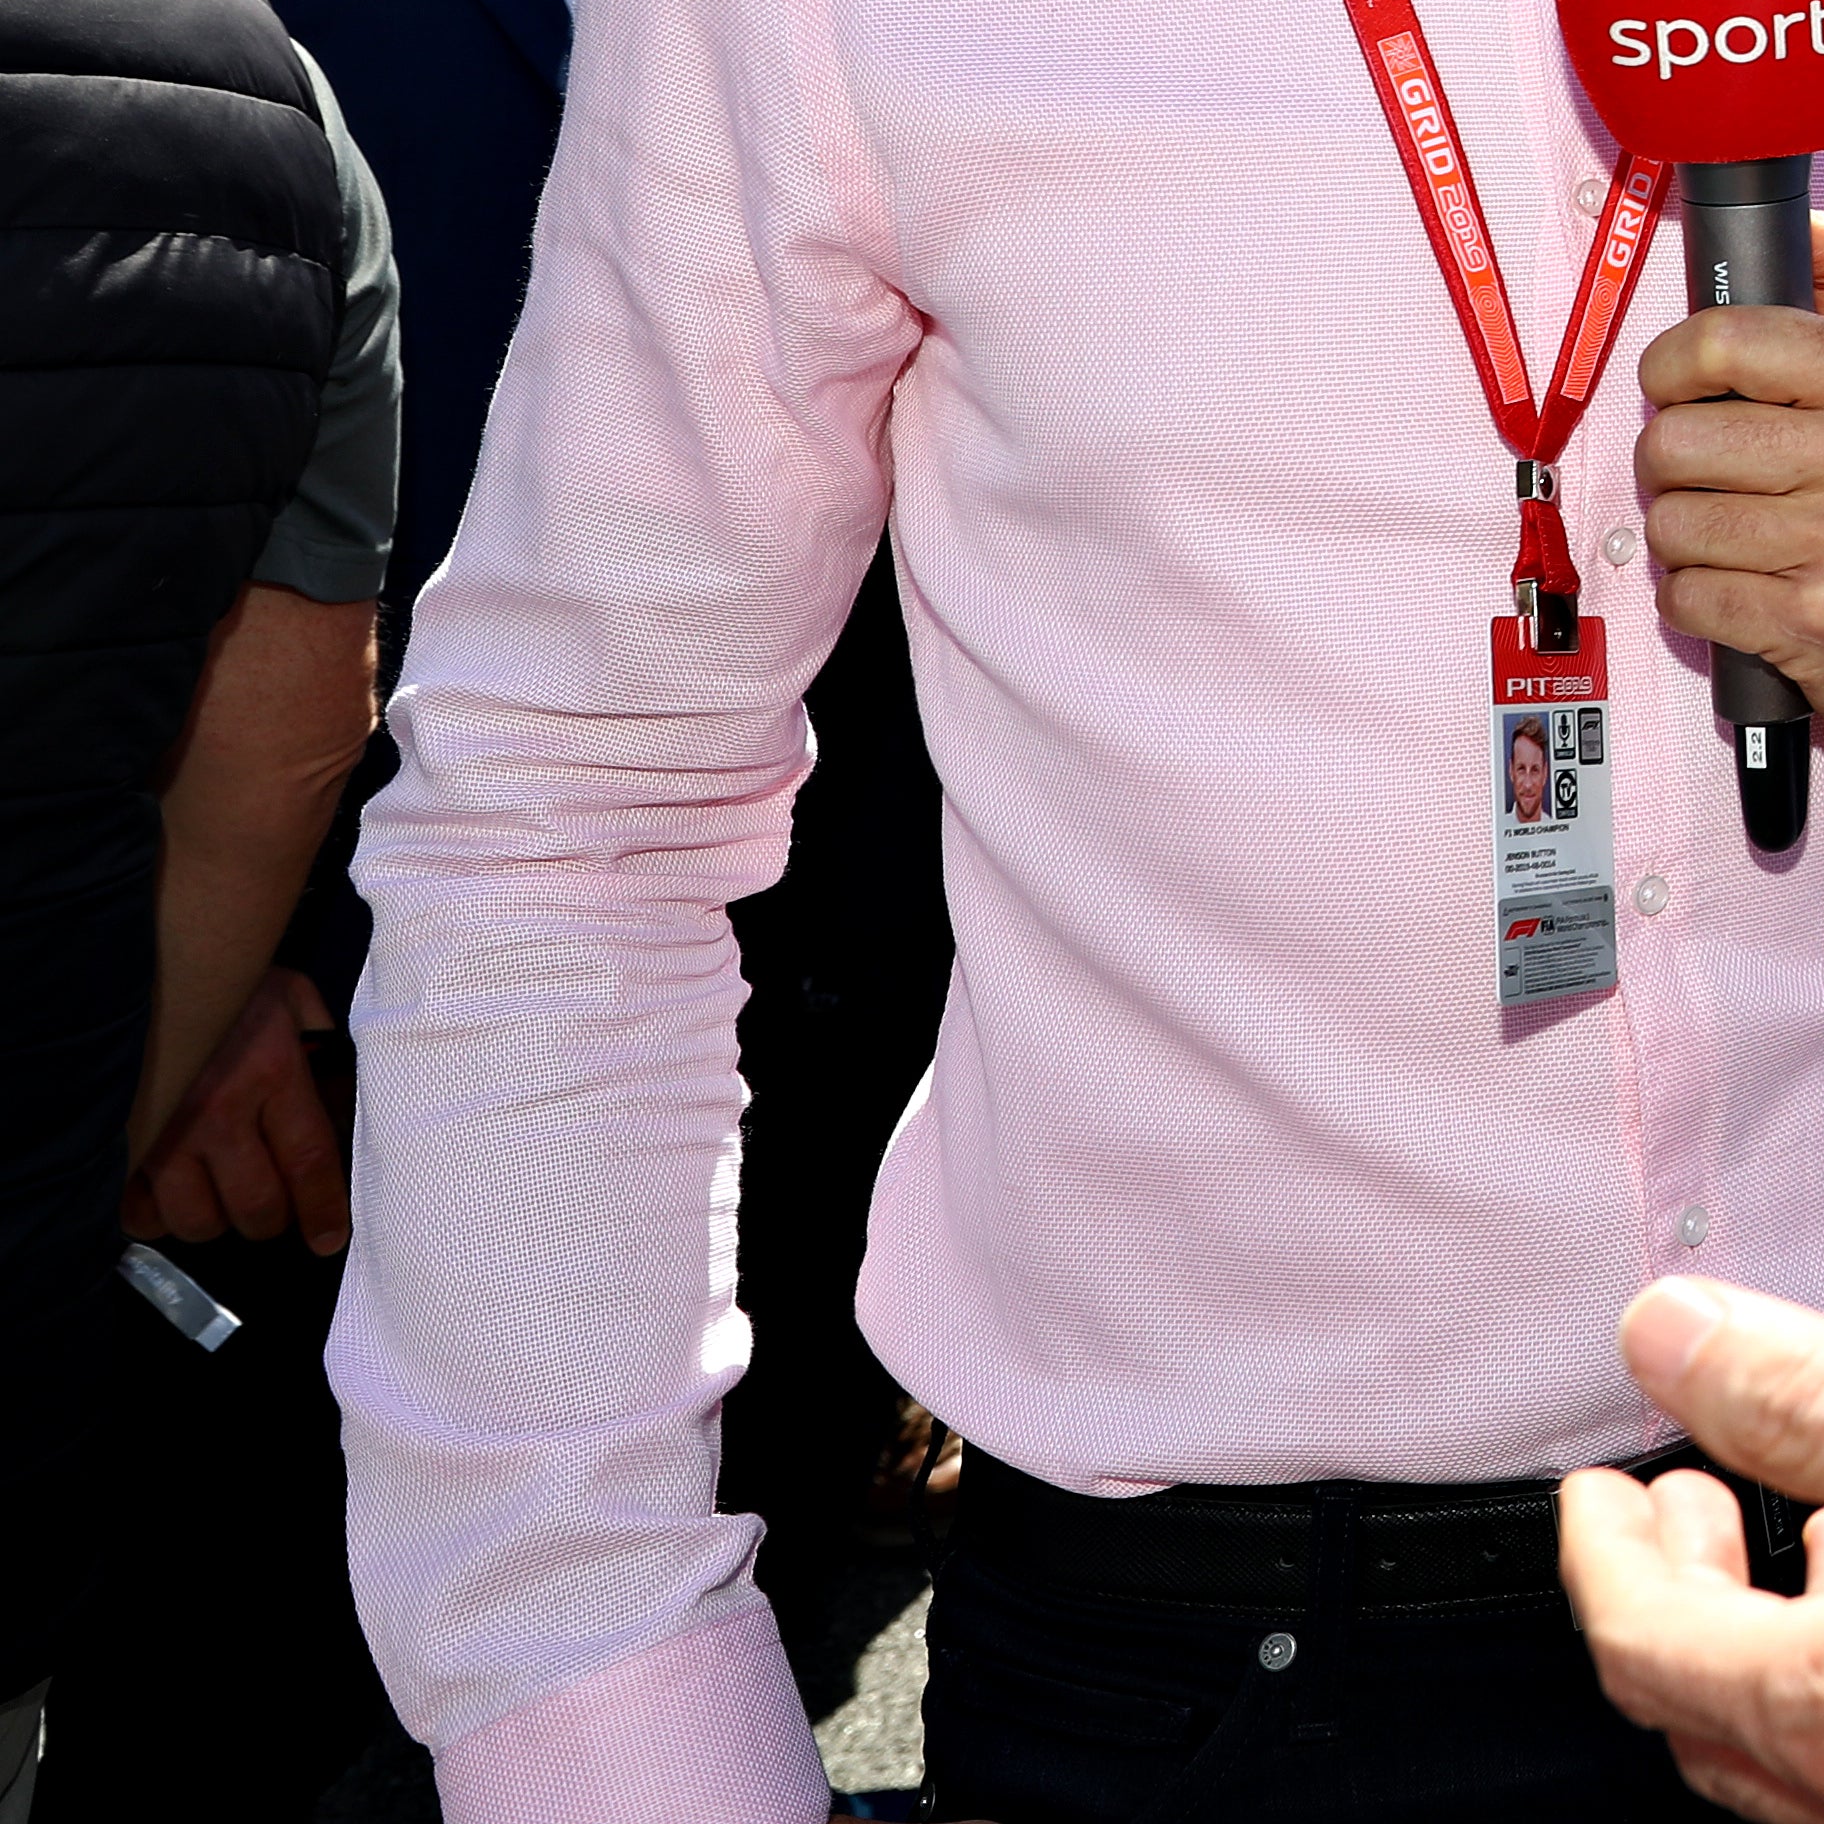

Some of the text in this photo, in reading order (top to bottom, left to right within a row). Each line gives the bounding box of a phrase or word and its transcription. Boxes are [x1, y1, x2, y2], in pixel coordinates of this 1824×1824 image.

[1396, 77, 1488, 274] GRID 2019
[1606, 172, 1652, 268] GRID
[1507, 675, 1593, 697] PIT 2019
[1751, 732, 1763, 763] 2.2
